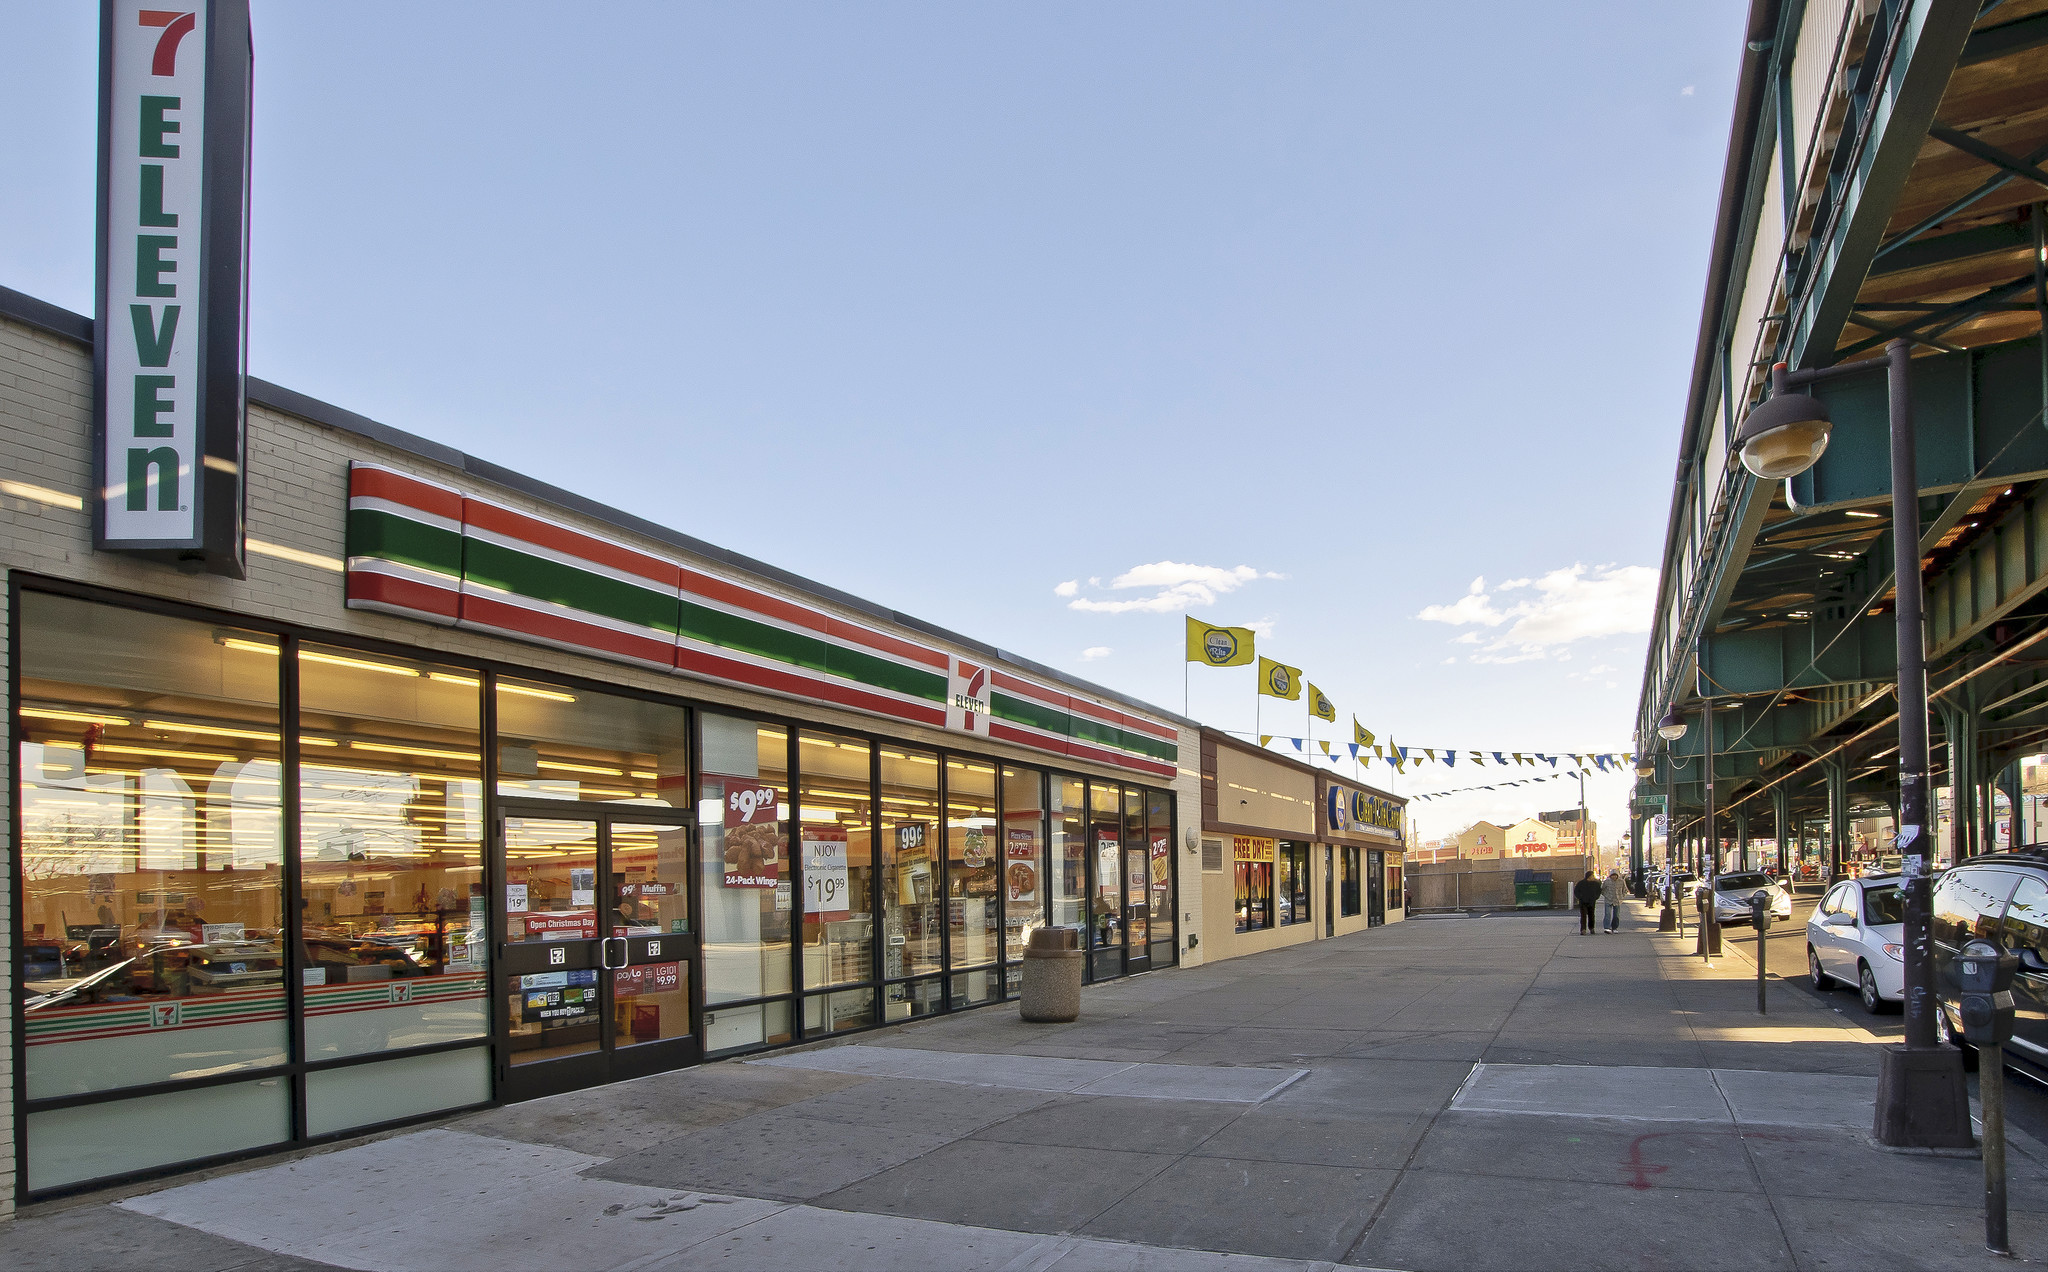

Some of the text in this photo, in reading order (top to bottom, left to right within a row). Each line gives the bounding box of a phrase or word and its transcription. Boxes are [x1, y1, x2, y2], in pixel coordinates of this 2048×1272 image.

[138, 10, 195, 77] 7
[957, 660, 985, 730] 7
[1648, 796, 1658, 804] 40
[814, 844, 837, 857] NJOY
[1233, 837, 1265, 860] FREE DRY
[1471, 847, 1494, 856] PETCO
[1515, 842, 1548, 854] PETCO
[725, 875, 778, 888] 24-Pack Wings
[641, 884, 667, 894] Muffin
[530, 917, 595, 930] Open Christmas Day
[616, 968, 642, 981] payLo
[656, 974, 677, 986] $9.99
[395, 985, 407, 1001] 7
[158, 1006, 174, 1025] 7
